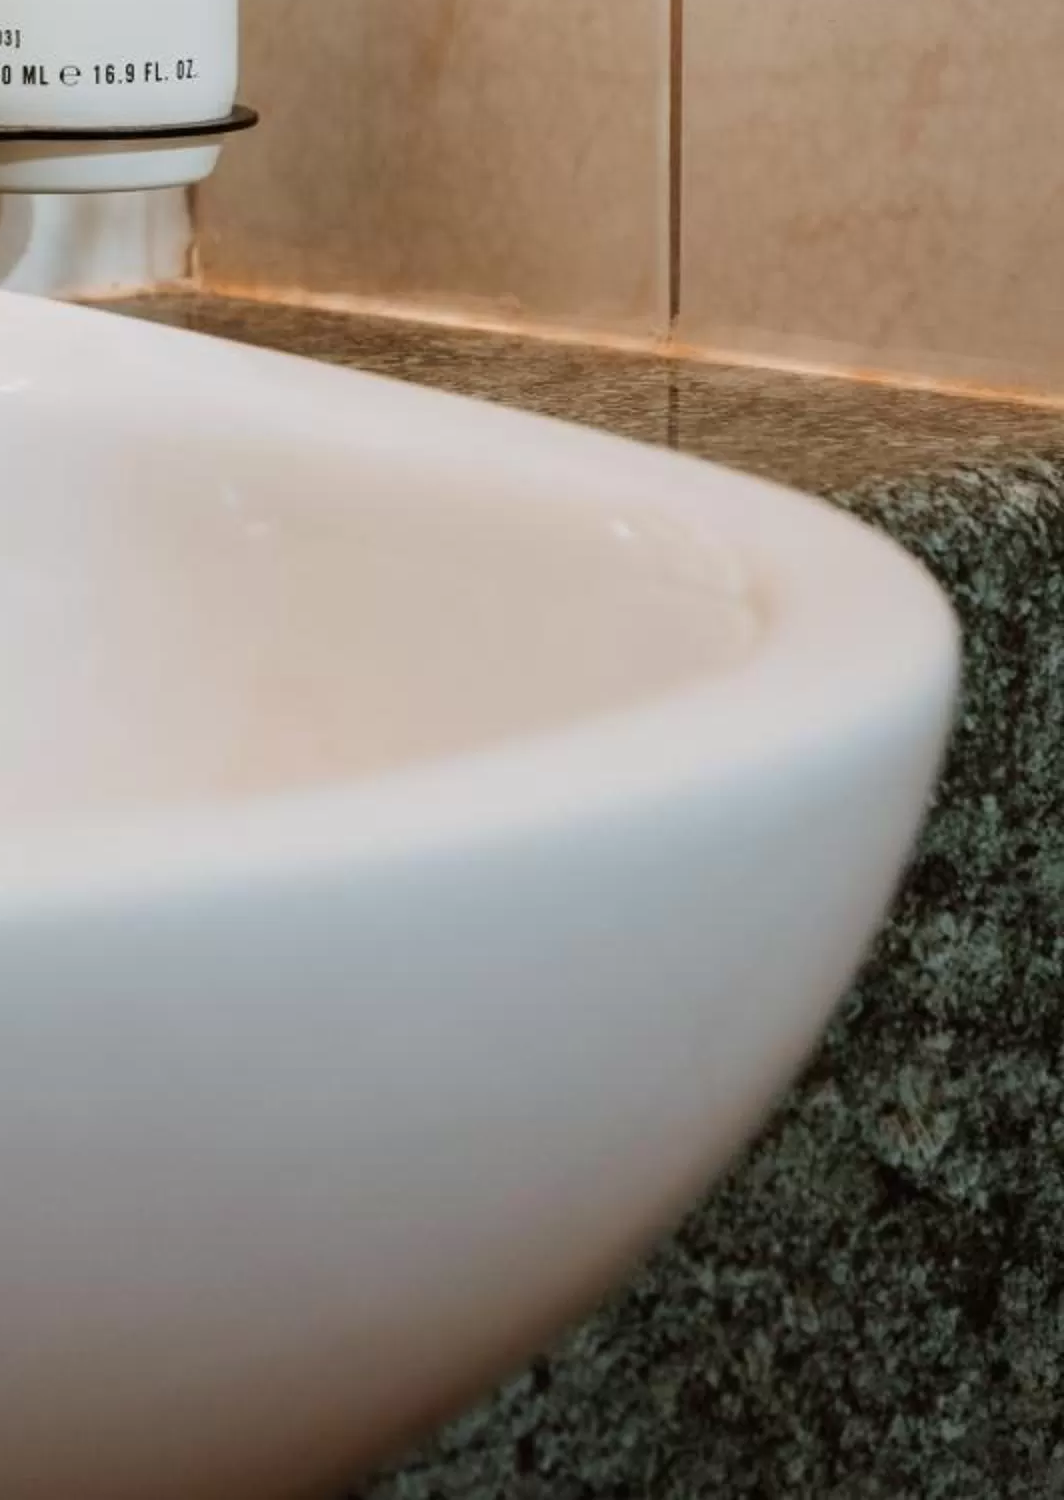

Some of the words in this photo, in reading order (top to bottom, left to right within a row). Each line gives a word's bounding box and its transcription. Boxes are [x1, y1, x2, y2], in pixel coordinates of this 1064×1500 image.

[22, 65, 49, 86] ML
[94, 63, 135, 84] 16.9
[144, 62, 168, 82] FL.
[176, 59, 197, 80] OZ.
